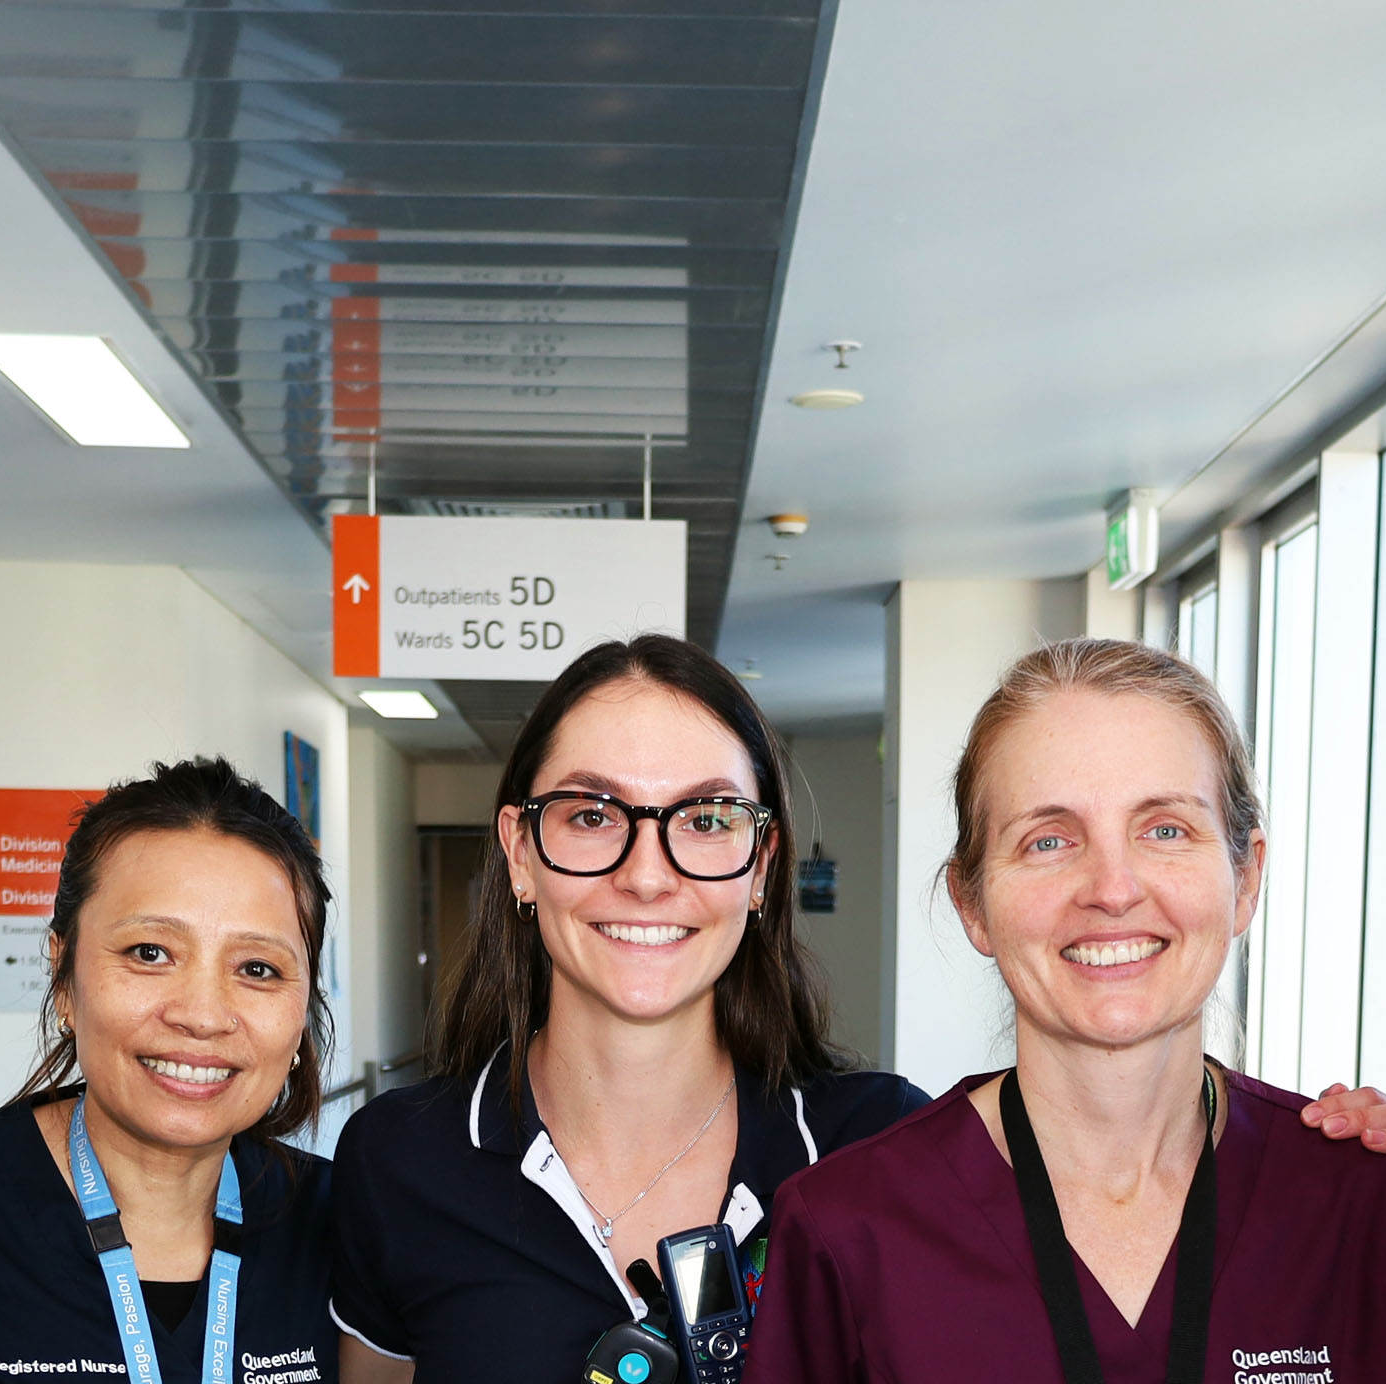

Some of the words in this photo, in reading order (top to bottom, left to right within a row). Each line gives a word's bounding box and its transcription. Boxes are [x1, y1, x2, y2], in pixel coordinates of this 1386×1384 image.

[394, 586, 502, 608] Outpatients
[509, 576, 556, 606] 5D
[395, 631, 454, 649] Wards
[462, 620, 505, 650] 5C
[519, 621, 565, 650] 5D
[0, 836, 61, 852] Division
[0, 857, 61, 873] Medicin
[76, 1138, 99, 1196] Nursing
[116, 1273, 142, 1336] Passion
[212, 1277, 232, 1336] Nursing
[81, 1358, 127, 1375] Nurse
[241, 1345, 316, 1370] Queensland
[1232, 1345, 1331, 1370] Queensland
